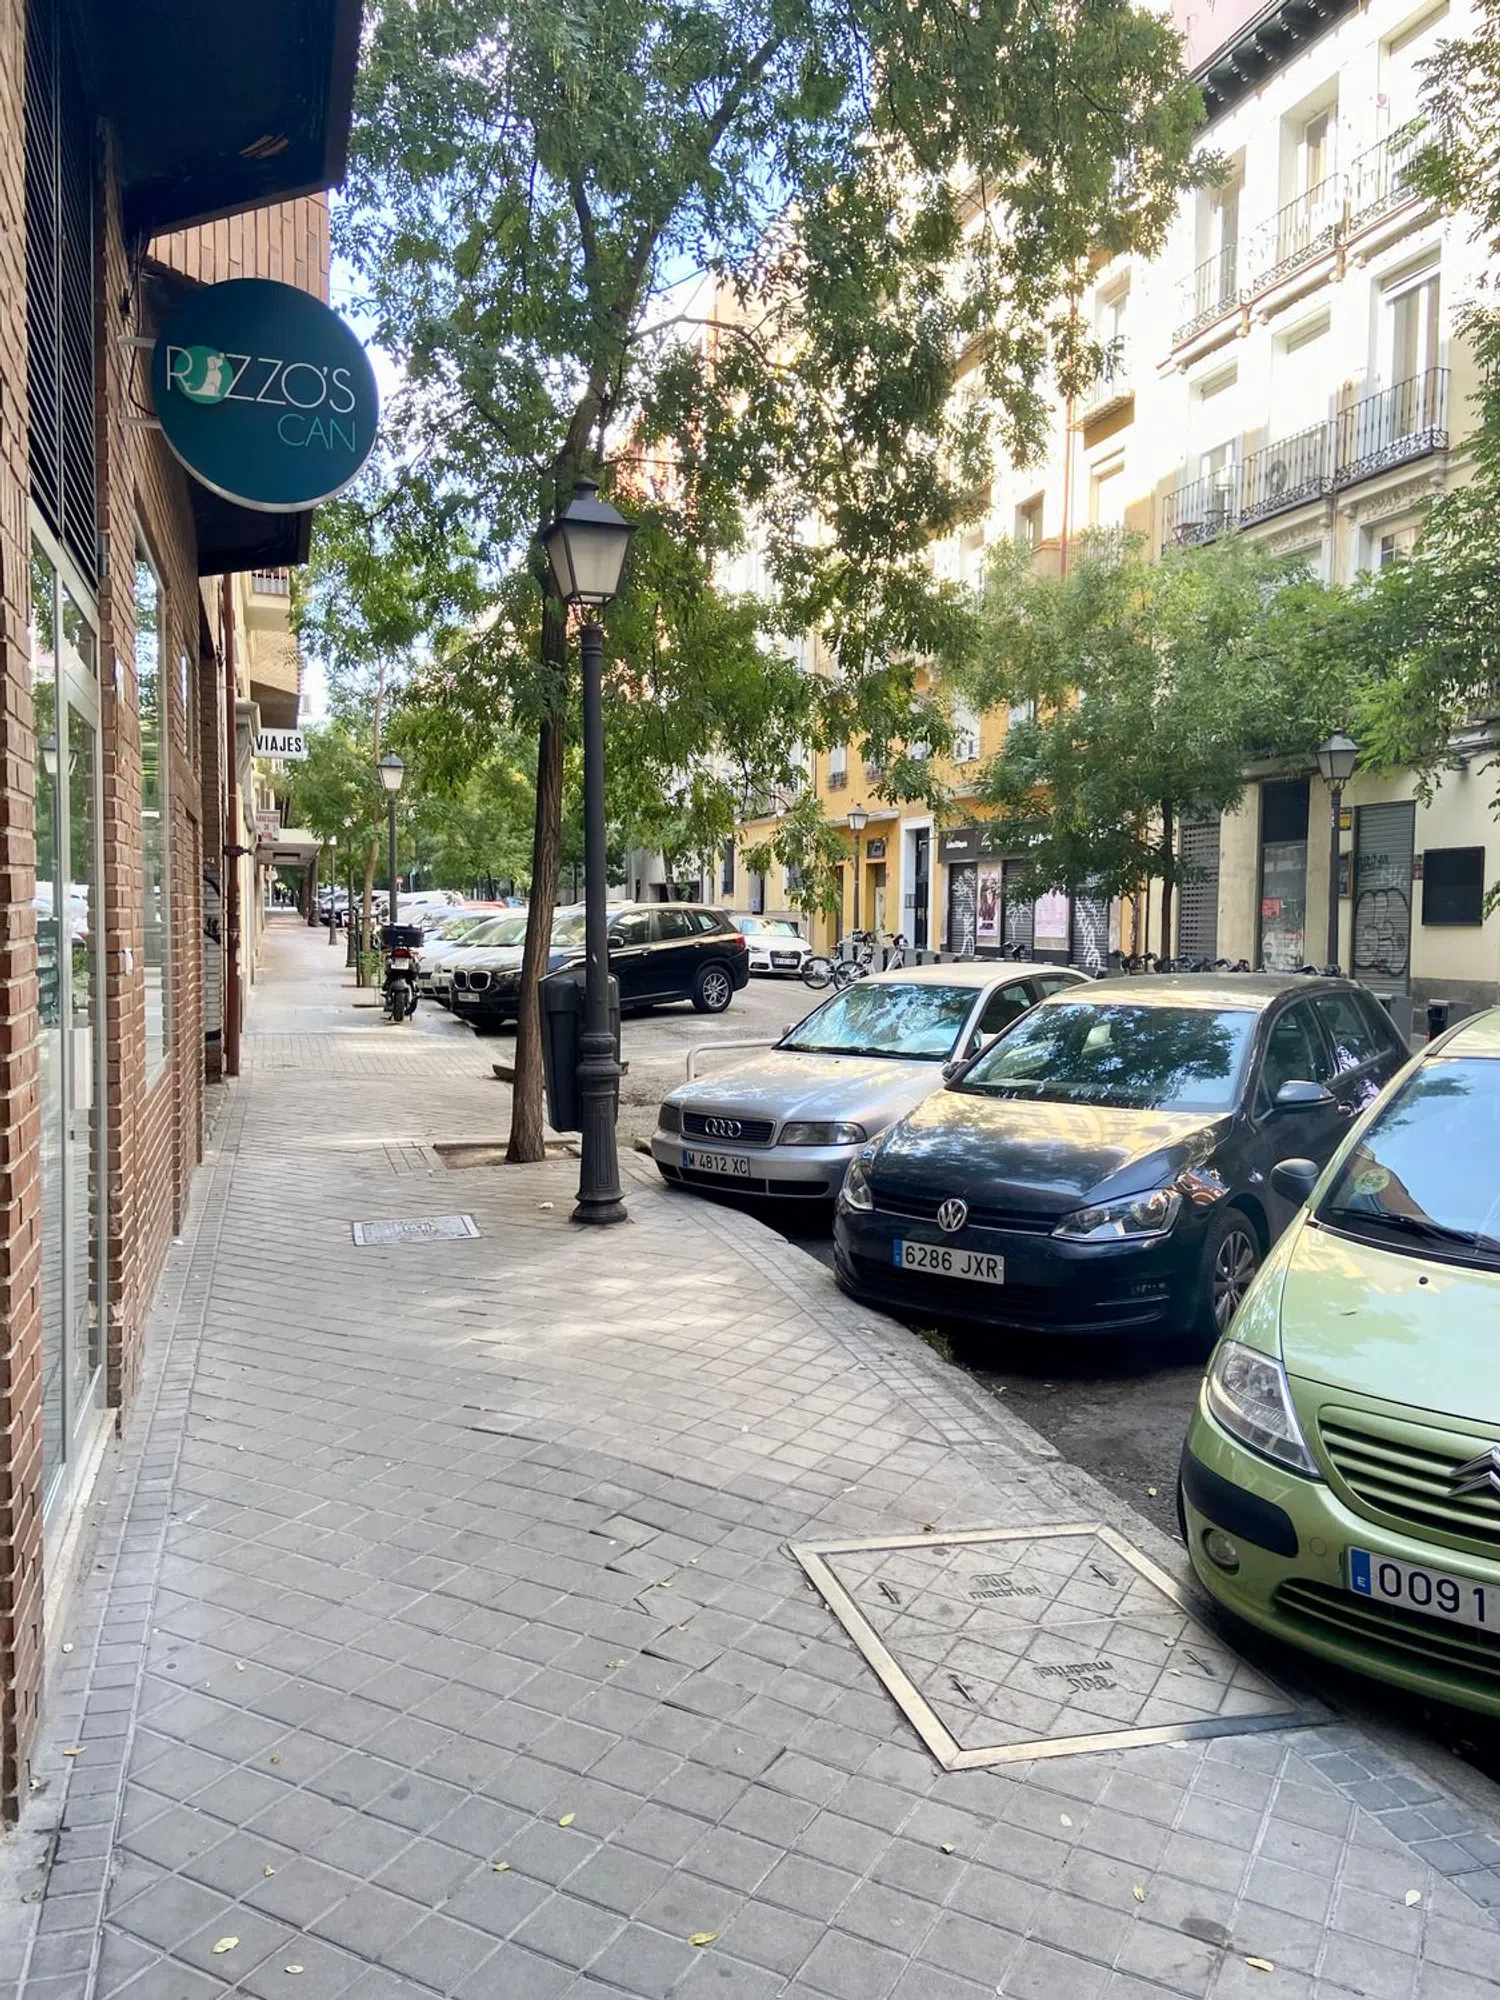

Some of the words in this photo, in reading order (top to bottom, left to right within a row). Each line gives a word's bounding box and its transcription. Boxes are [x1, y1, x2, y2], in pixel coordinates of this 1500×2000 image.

[277, 413, 356, 453] CAN
[256, 735, 302, 752] VIAJES
[699, 1154, 727, 1172] 4812
[731, 1158, 747, 1174] XC
[905, 1245, 953, 1271] 6286
[960, 1254, 998, 1279] JXR
[1378, 1563, 1485, 1622] 0091
